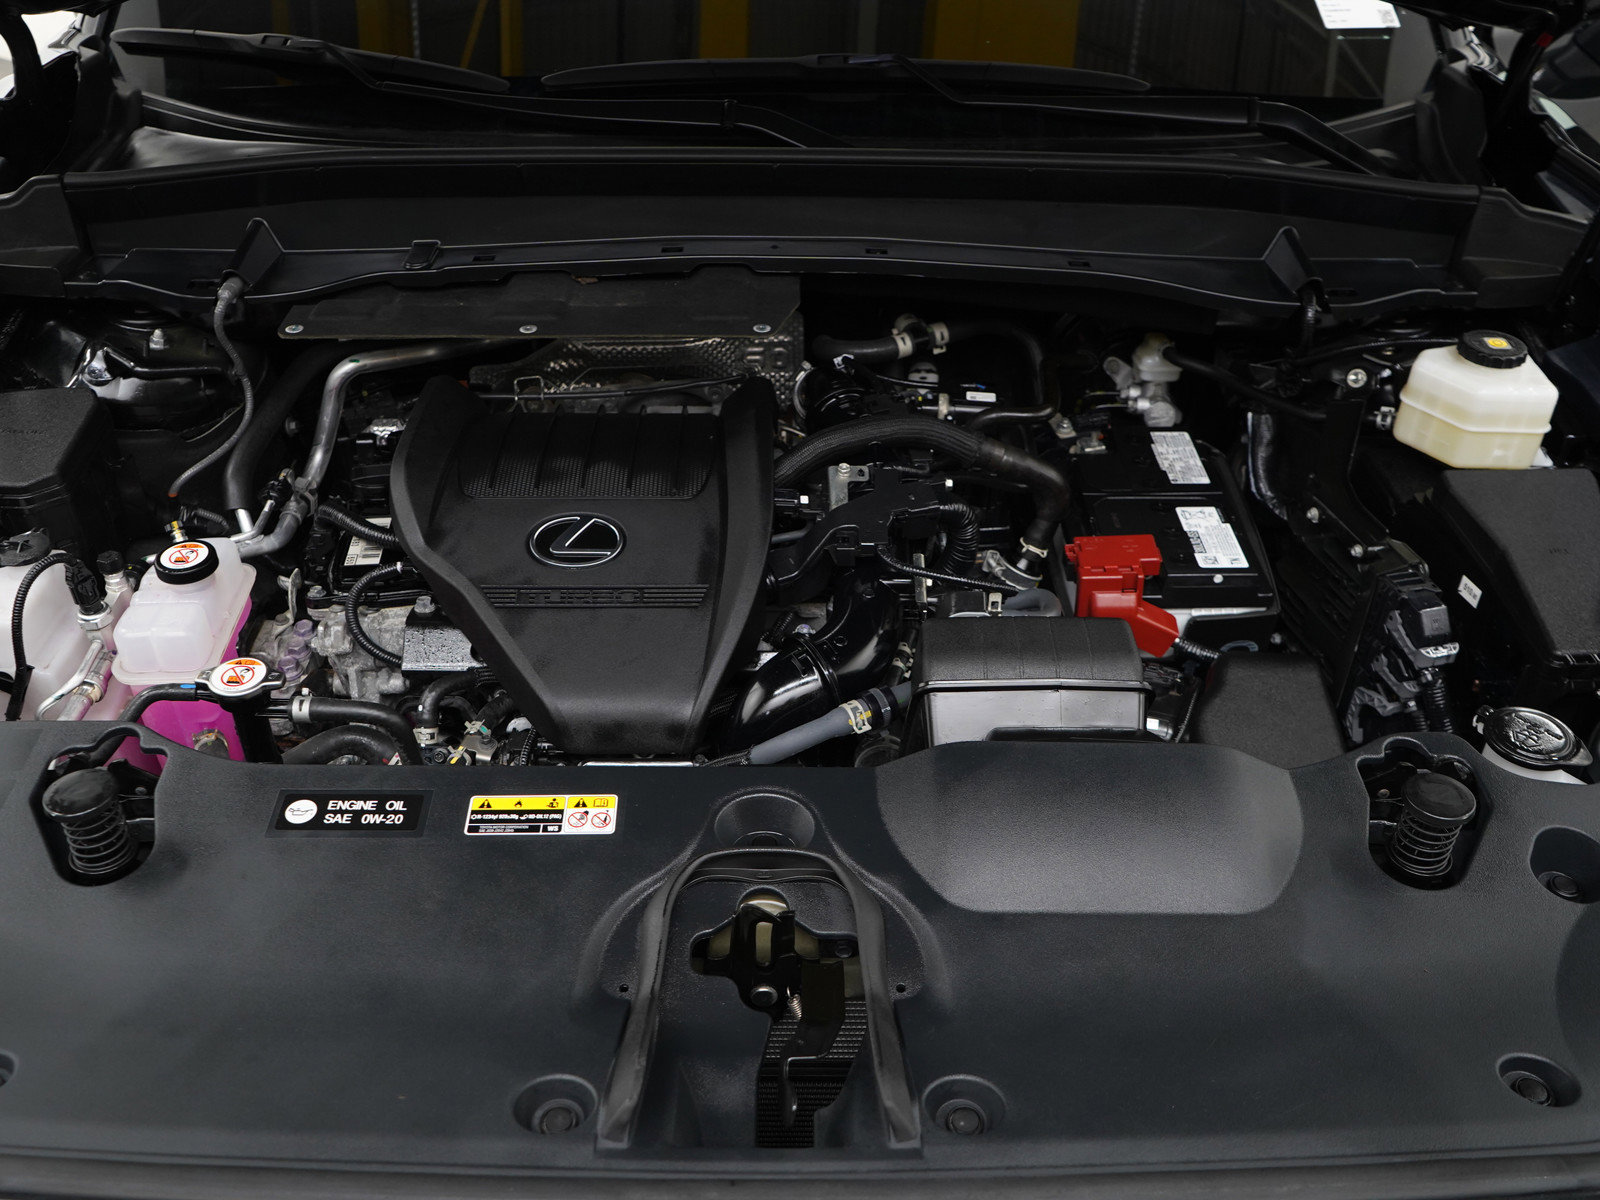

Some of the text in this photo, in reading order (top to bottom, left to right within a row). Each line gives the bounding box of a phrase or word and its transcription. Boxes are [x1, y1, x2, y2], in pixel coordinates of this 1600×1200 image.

[327, 800, 407, 811] ENGINE OIL
[323, 813, 404, 825] SAE 0W-20
